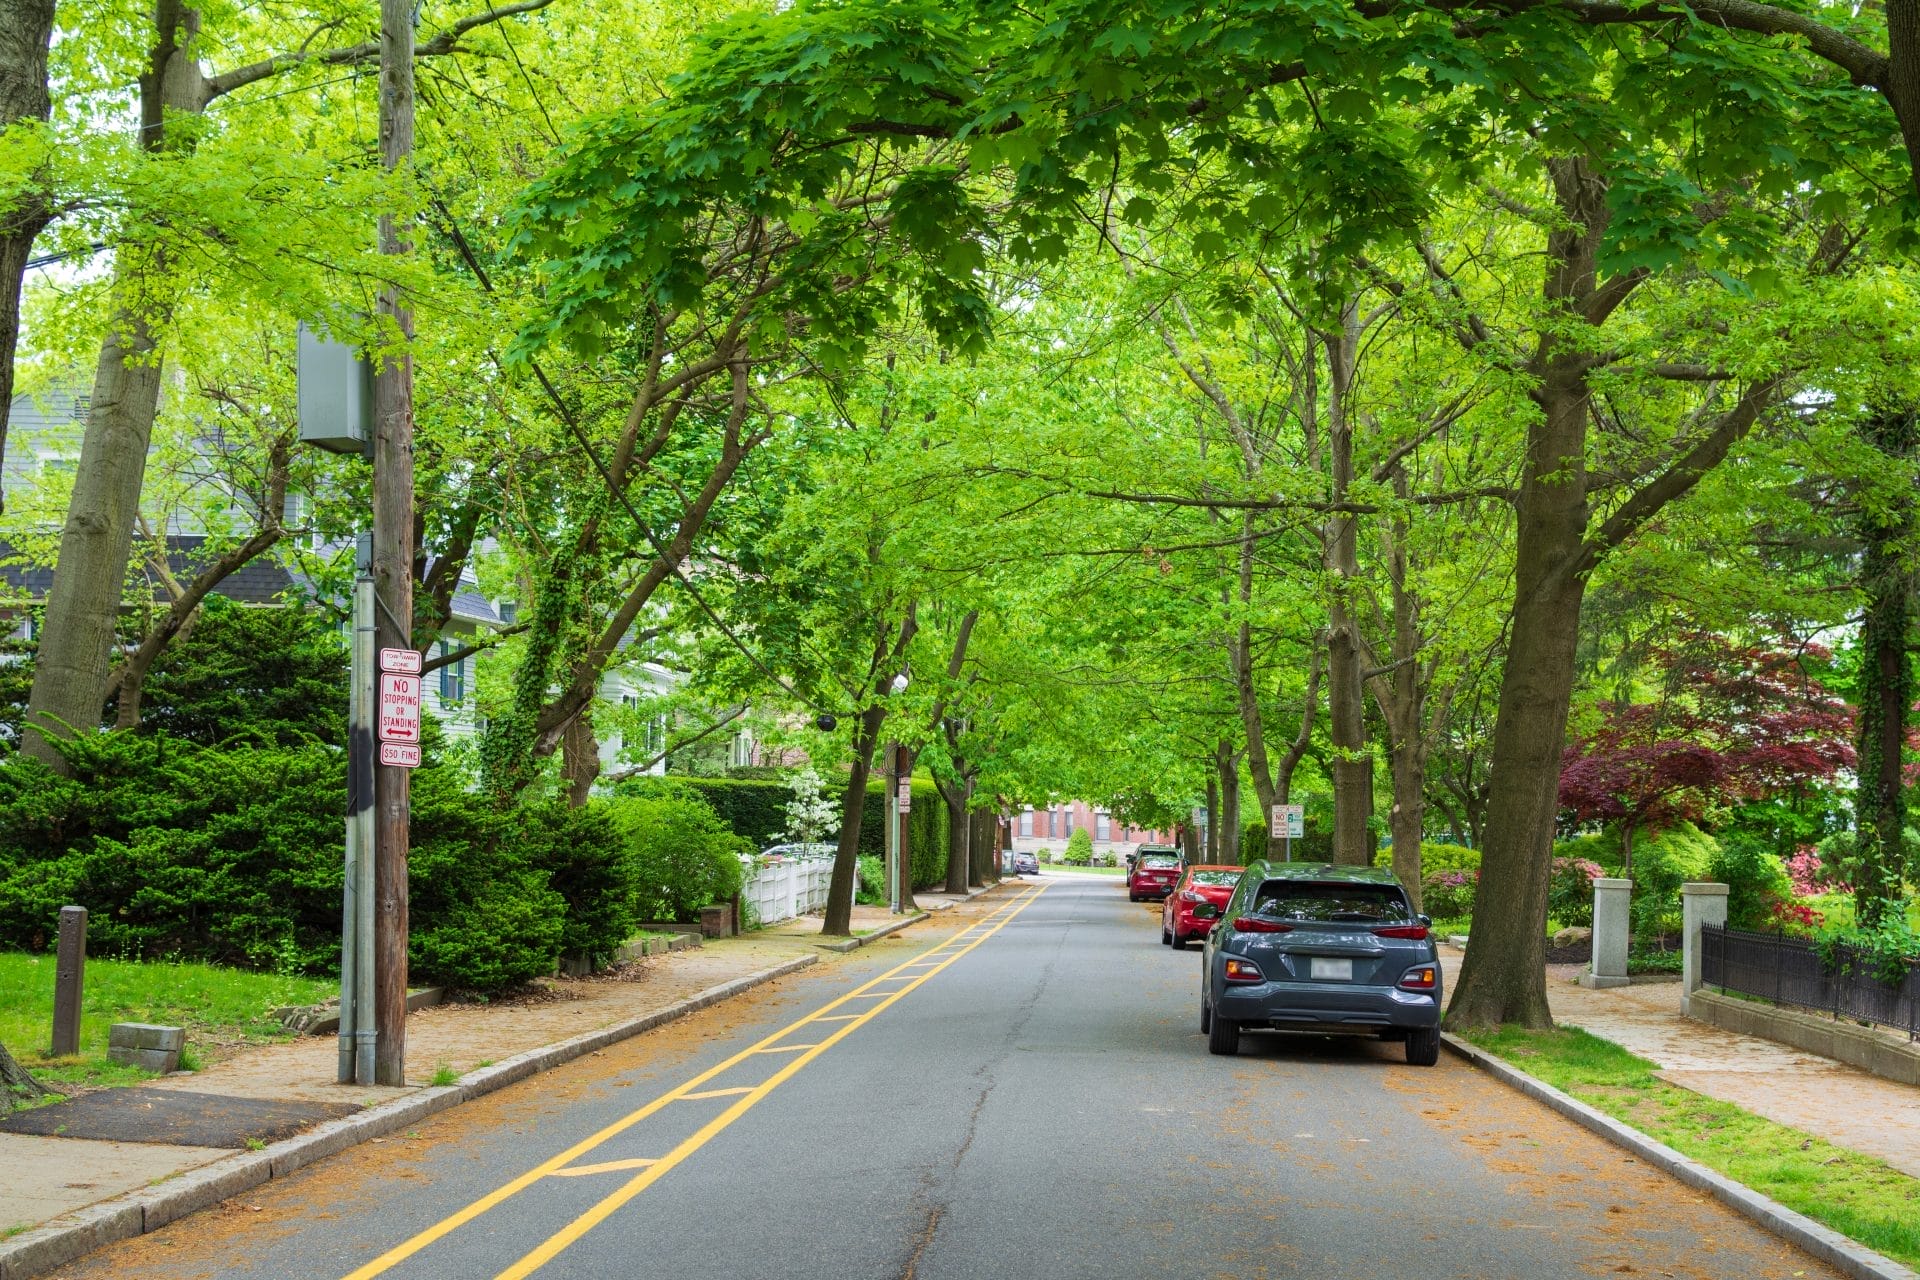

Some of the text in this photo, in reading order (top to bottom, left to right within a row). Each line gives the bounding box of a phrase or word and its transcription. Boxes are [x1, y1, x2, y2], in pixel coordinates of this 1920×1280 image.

[394, 680, 408, 693] NO
[384, 694, 417, 706] STOPPING
[396, 707, 405, 716] OR
[383, 717, 417, 729] STANDING
[384, 749, 417, 760] $50 FINE
